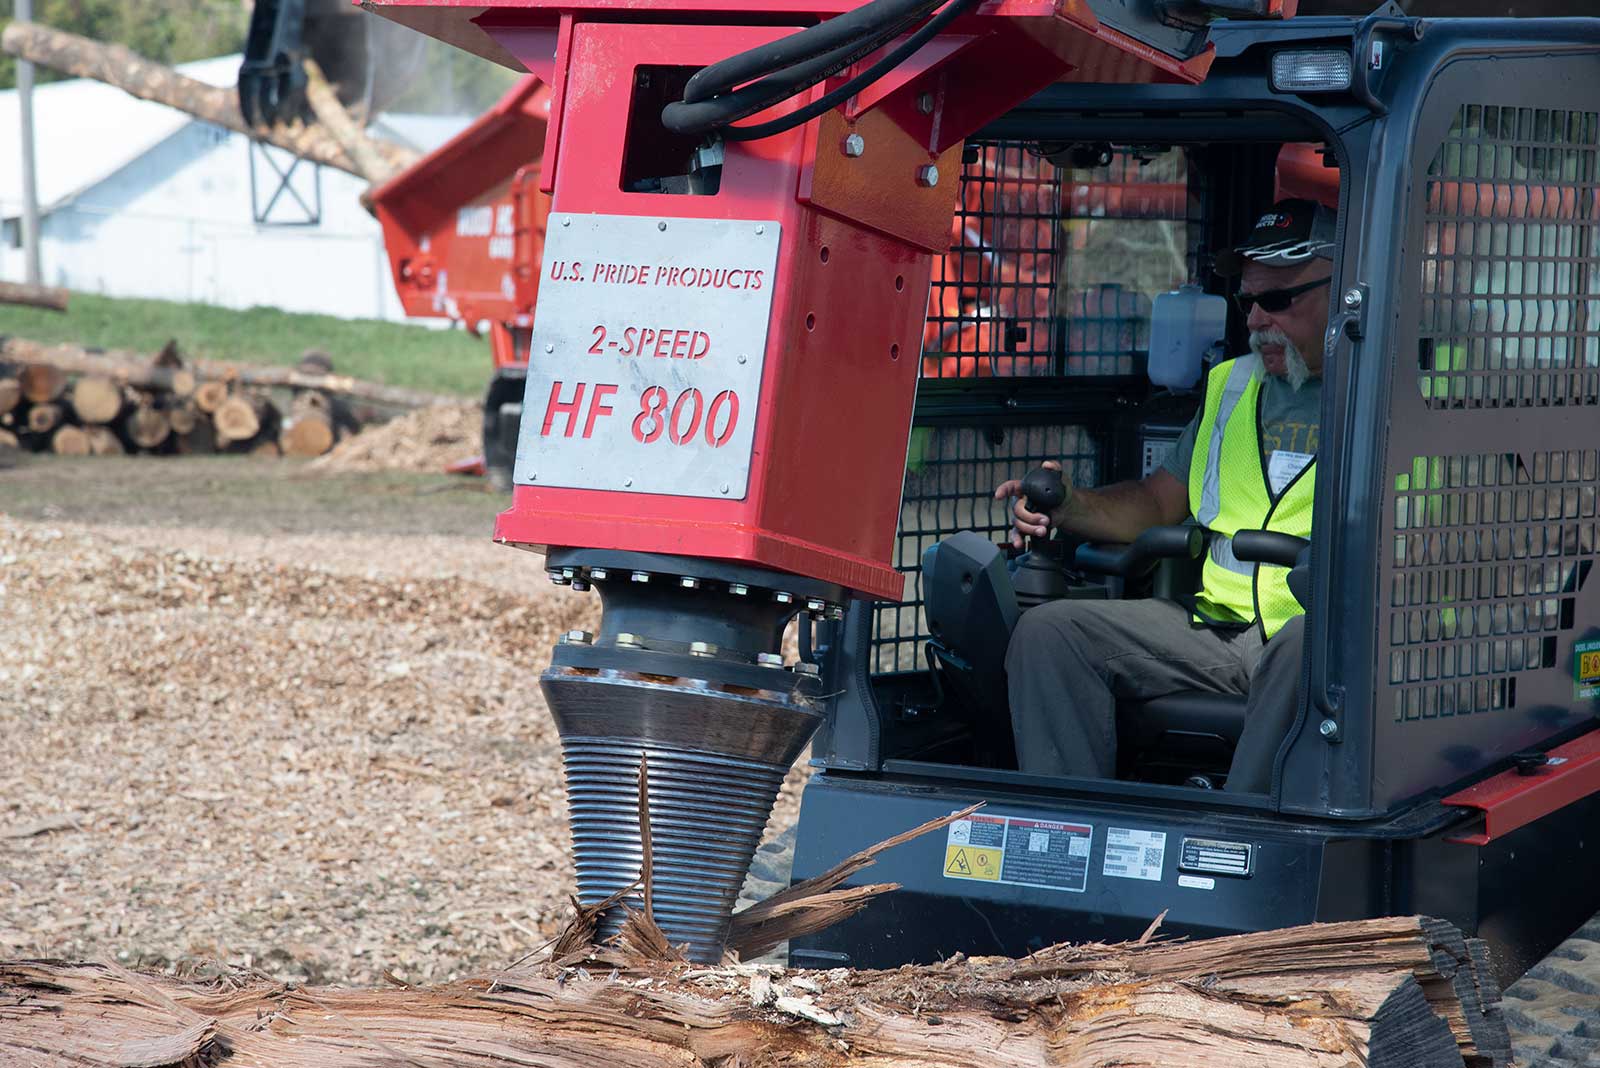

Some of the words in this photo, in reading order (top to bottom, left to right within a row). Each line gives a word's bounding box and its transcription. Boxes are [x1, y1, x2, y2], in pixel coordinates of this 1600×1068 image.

[550, 260, 586, 282] U.S.
[591, 263, 651, 285] PRIDE
[654, 266, 765, 290] PRODUCTS
[588, 325, 711, 360] 2-SPEED
[540, 380, 619, 439] HF
[631, 385, 740, 449] 800
[1040, 823, 1064, 831] DANGER
